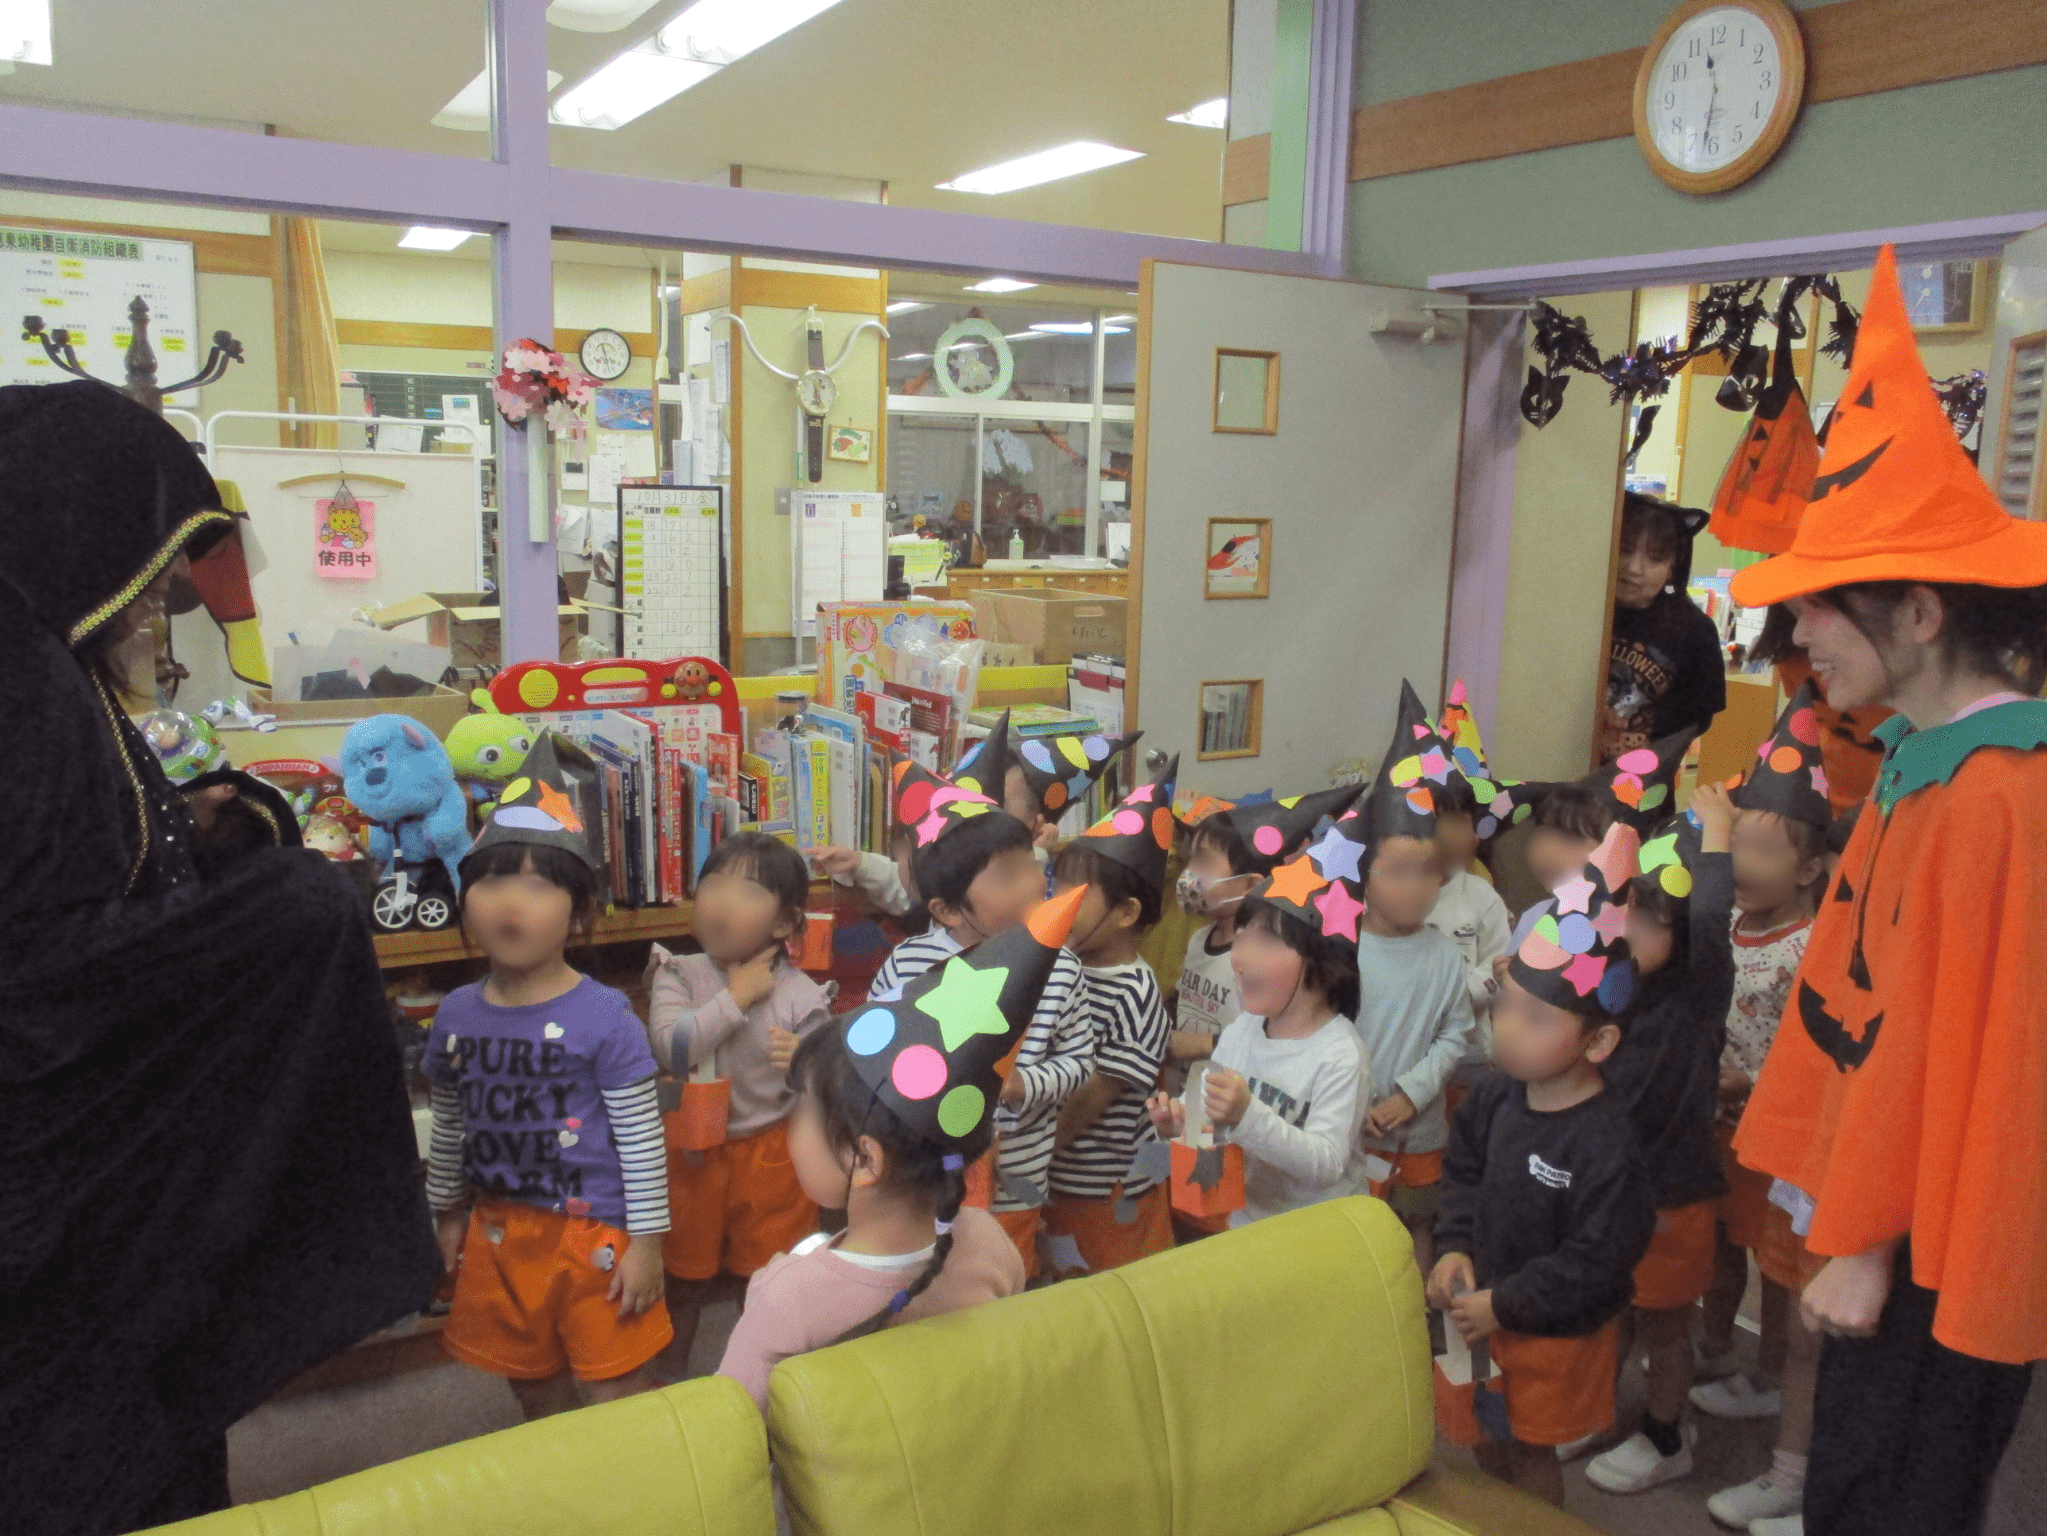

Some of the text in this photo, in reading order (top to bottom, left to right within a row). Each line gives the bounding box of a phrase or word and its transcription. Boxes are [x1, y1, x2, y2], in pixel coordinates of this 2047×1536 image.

[1710, 24, 1726, 46] 12
[1739, 28, 1745, 47] 1
[1689, 37, 1700, 58] 11
[1753, 44, 1764, 65] 2
[1671, 61, 1687, 82] 10
[1759, 70, 1771, 91] 3
[1664, 91, 1675, 110] 9
[1671, 117, 1682, 135] 8
[1732, 124, 1742, 143] 5
[1708, 136, 1719, 155] 6
[0, 231, 139, 260] 泉幼稚園自衛消防組織表
[318, 550, 372, 567] 使用中
[1202, 979, 1231, 1005] DAY
[458, 1037, 566, 1077] PURE
